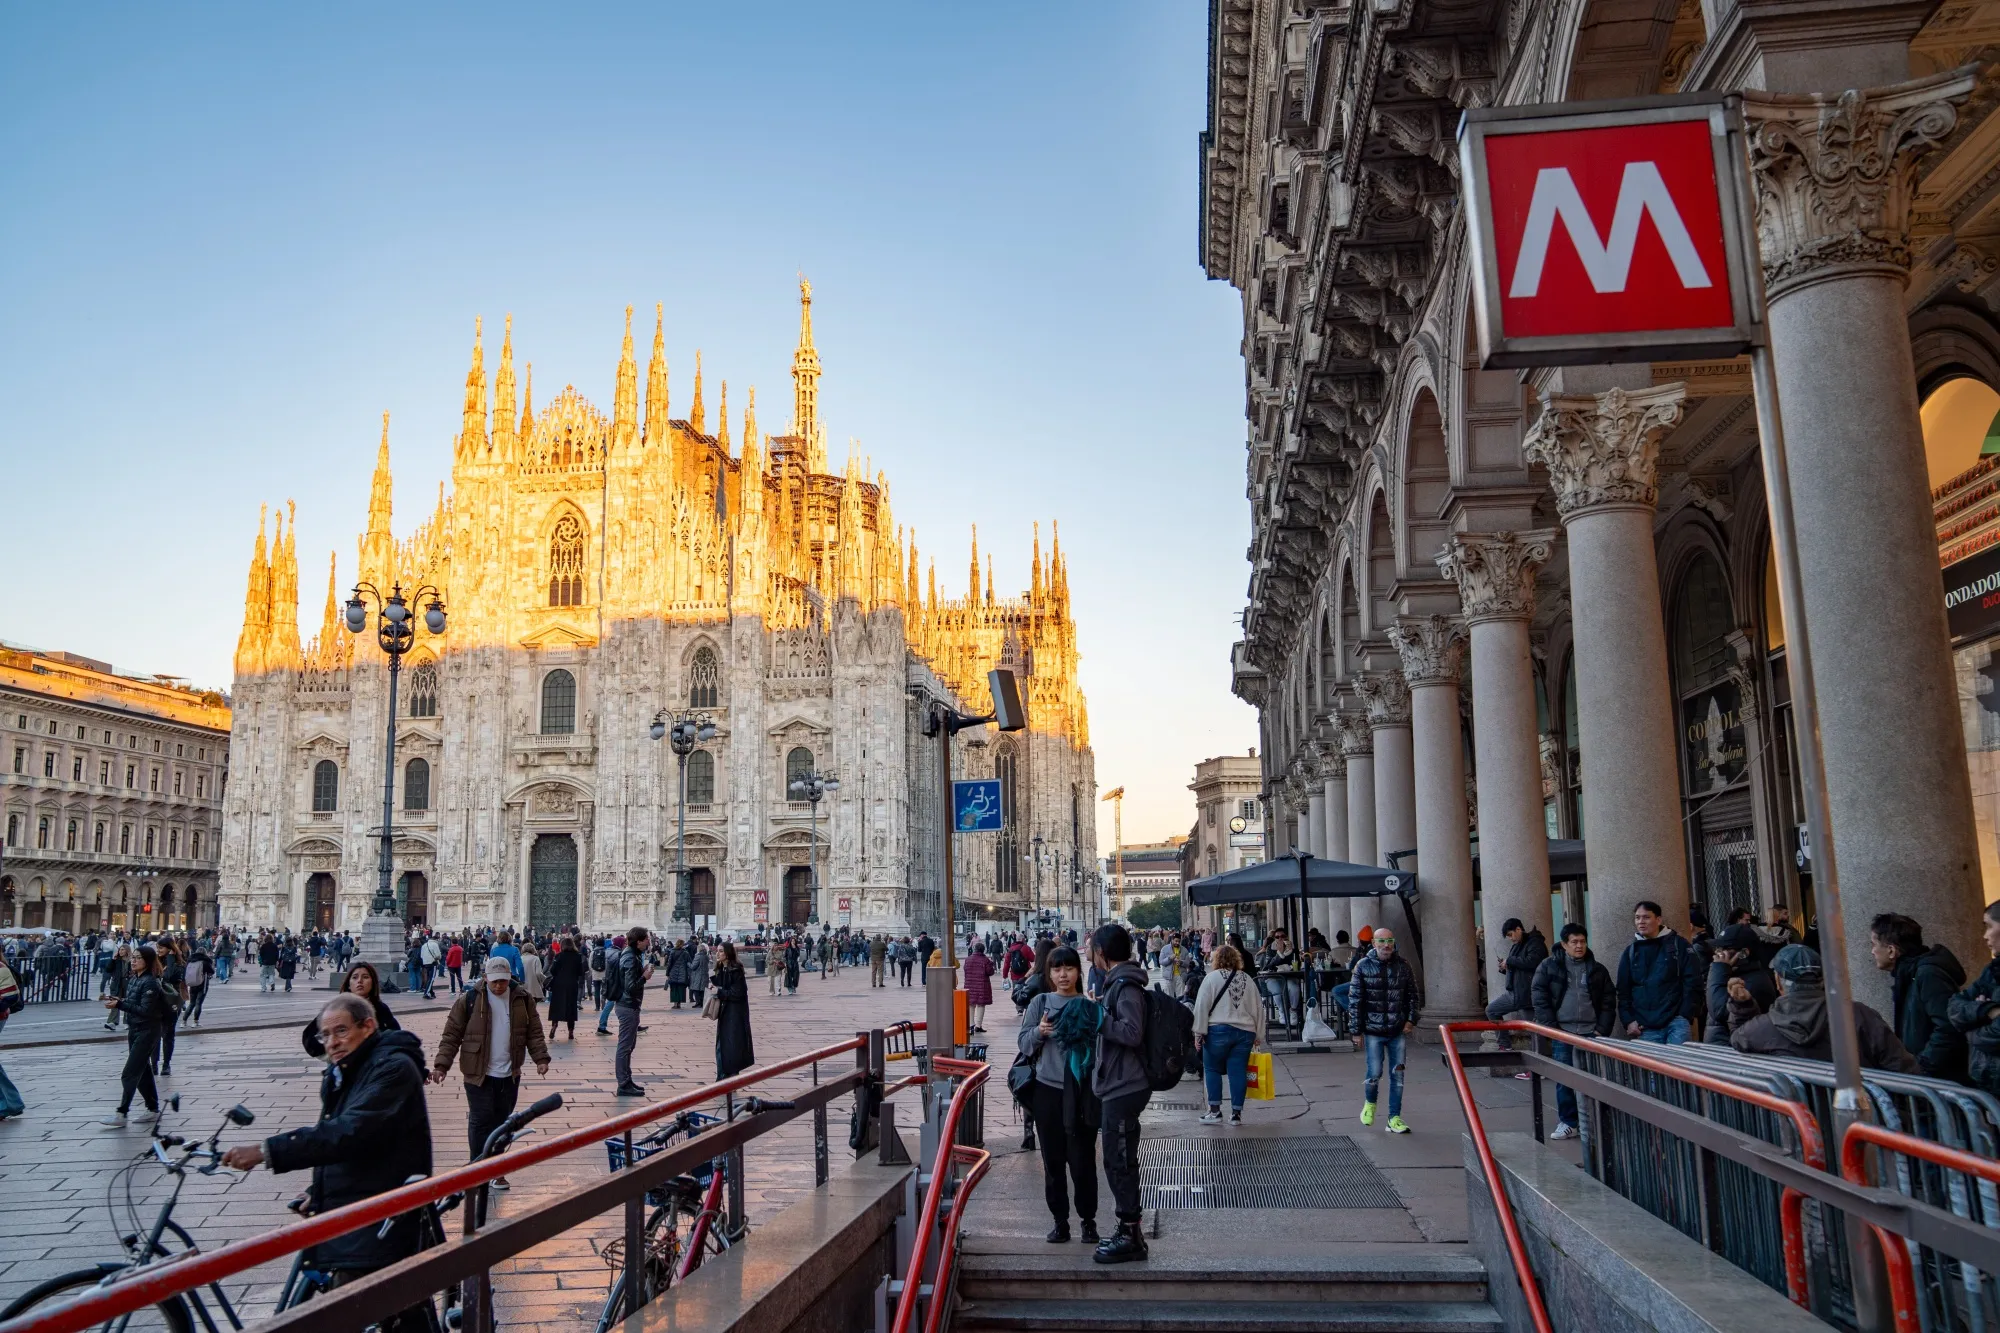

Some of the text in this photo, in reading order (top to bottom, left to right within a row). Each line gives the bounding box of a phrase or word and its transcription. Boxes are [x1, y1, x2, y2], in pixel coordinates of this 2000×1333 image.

[1509, 161, 1713, 298] M
[1945, 571, 2000, 608] ONDADO
[755, 893, 766, 901] M
